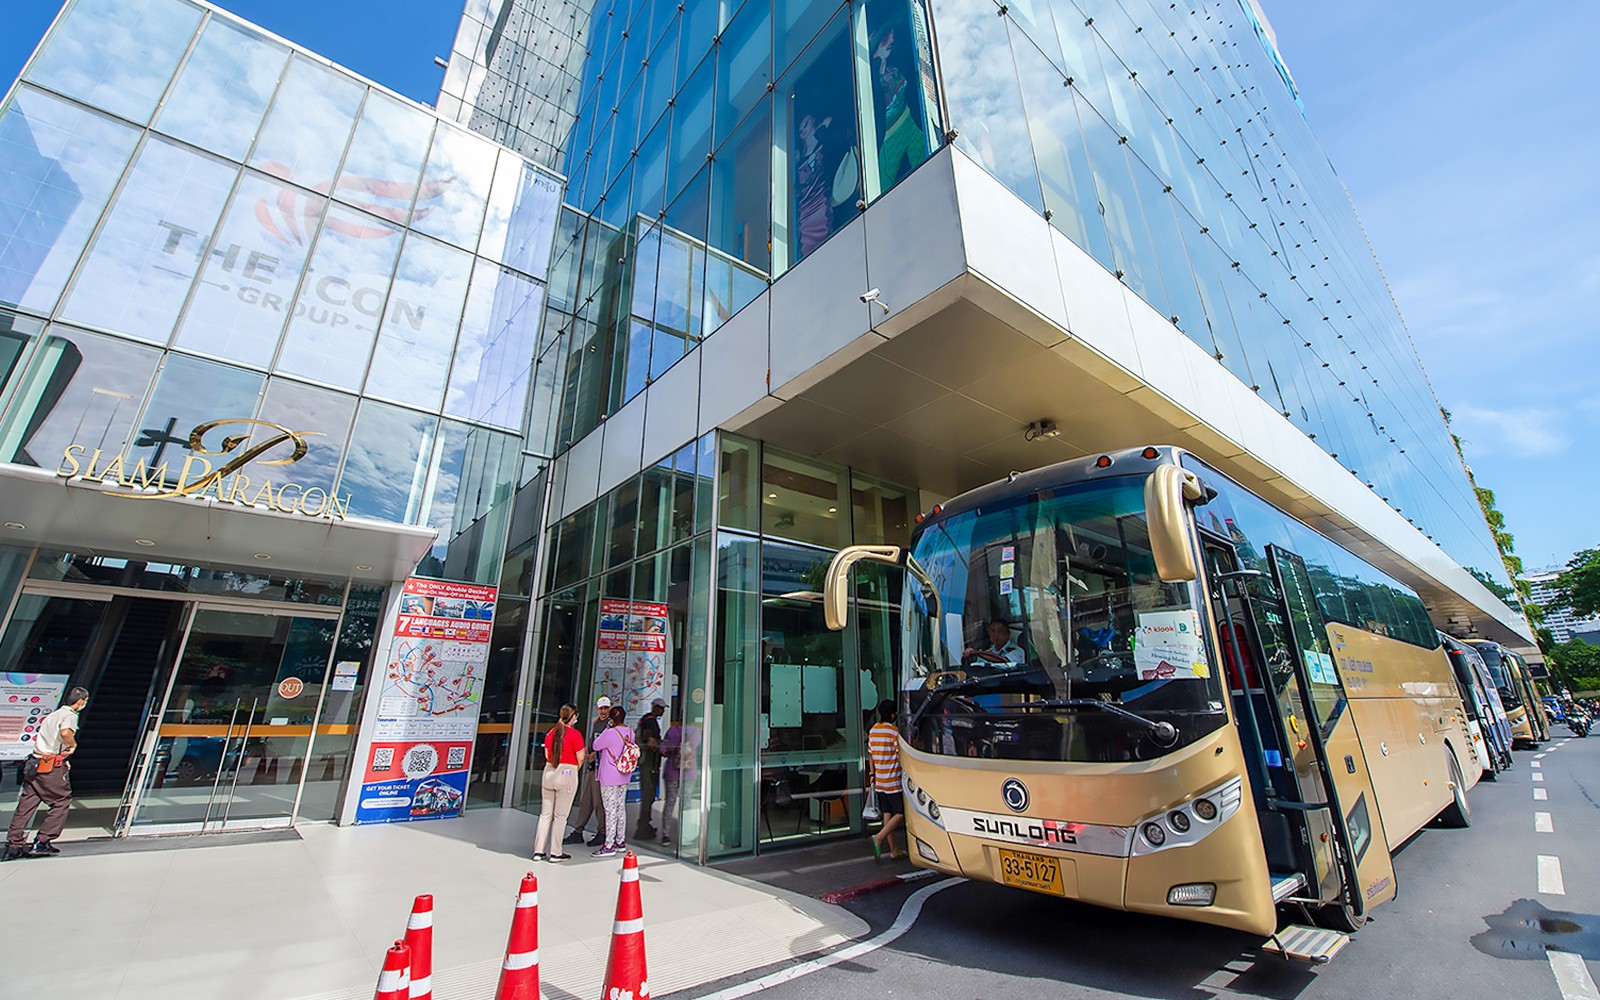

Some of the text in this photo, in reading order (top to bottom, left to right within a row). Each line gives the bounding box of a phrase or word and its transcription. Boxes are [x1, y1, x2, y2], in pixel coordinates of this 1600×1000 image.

[158, 219, 280, 285] THE
[237, 285, 350, 329] GROUP
[56, 444, 353, 520] SIAM PARAGON
[416, 582, 489, 595] The ONLY Double Decker
[398, 616, 410, 632] 7
[411, 617, 491, 631] LANGUAGES AUDIO GUIDE
[281, 682, 301, 693] OUT
[973, 817, 1077, 845] SUNLONG
[1012, 852, 1045, 863] THAILAND
[1004, 857, 1057, 883] 33-5127
